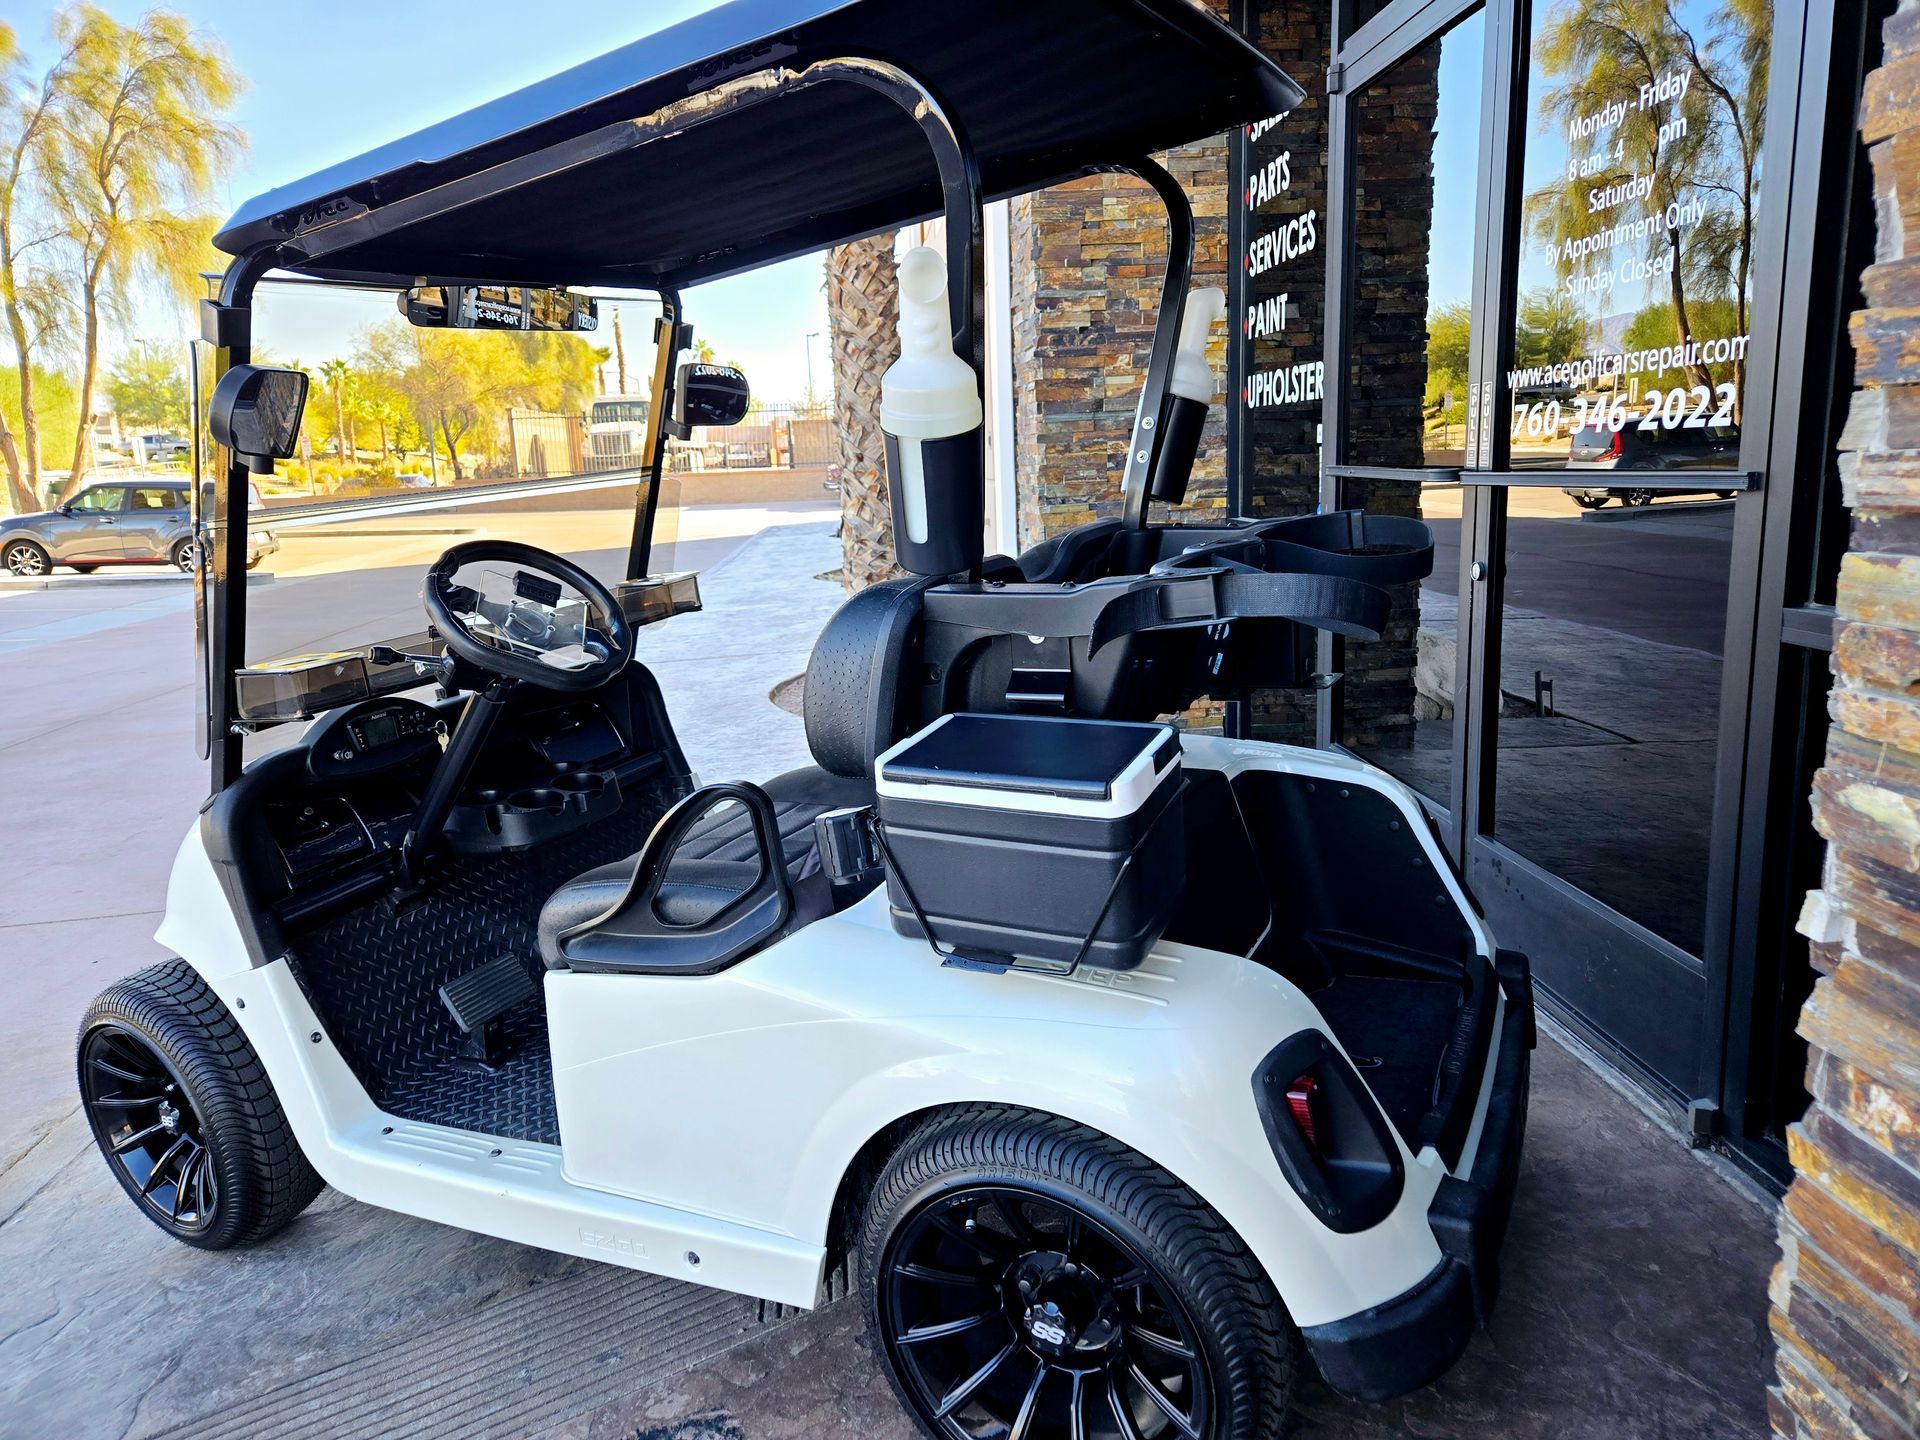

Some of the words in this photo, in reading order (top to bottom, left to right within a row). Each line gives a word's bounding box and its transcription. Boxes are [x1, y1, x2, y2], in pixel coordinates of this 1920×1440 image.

[1569, 99, 1628, 143] Monday
[1639, 69, 1692, 113] Friday
[1568, 158, 1578, 182] 8
[1579, 155, 1602, 178] am
[1613, 138, 1625, 162] 4
[1657, 116, 1687, 153] pm
[1249, 150, 1291, 212] PARTS
[1588, 172, 1656, 214] Saturday
[1249, 209, 1316, 278] SERVICES
[1545, 243, 1560, 271] By
[1563, 210, 1662, 265] Appointment
[1665, 197, 1708, 231] Only
[1565, 268, 1617, 298] Sunday
[1621, 245, 1675, 284] Closed
[1248, 293, 1289, 340] PAINT
[1247, 360, 1324, 409] UPHOLSTER
[1507, 334, 1750, 389] www.acegolfcarsrepair.com
[1470, 395, 1478, 442] PULL
[1483, 393, 1491, 441] PULL
[1511, 382, 1736, 438] 760-346-2022
[1072, 965, 1132, 987] TEP
[1031, 1321, 1066, 1345] SS
